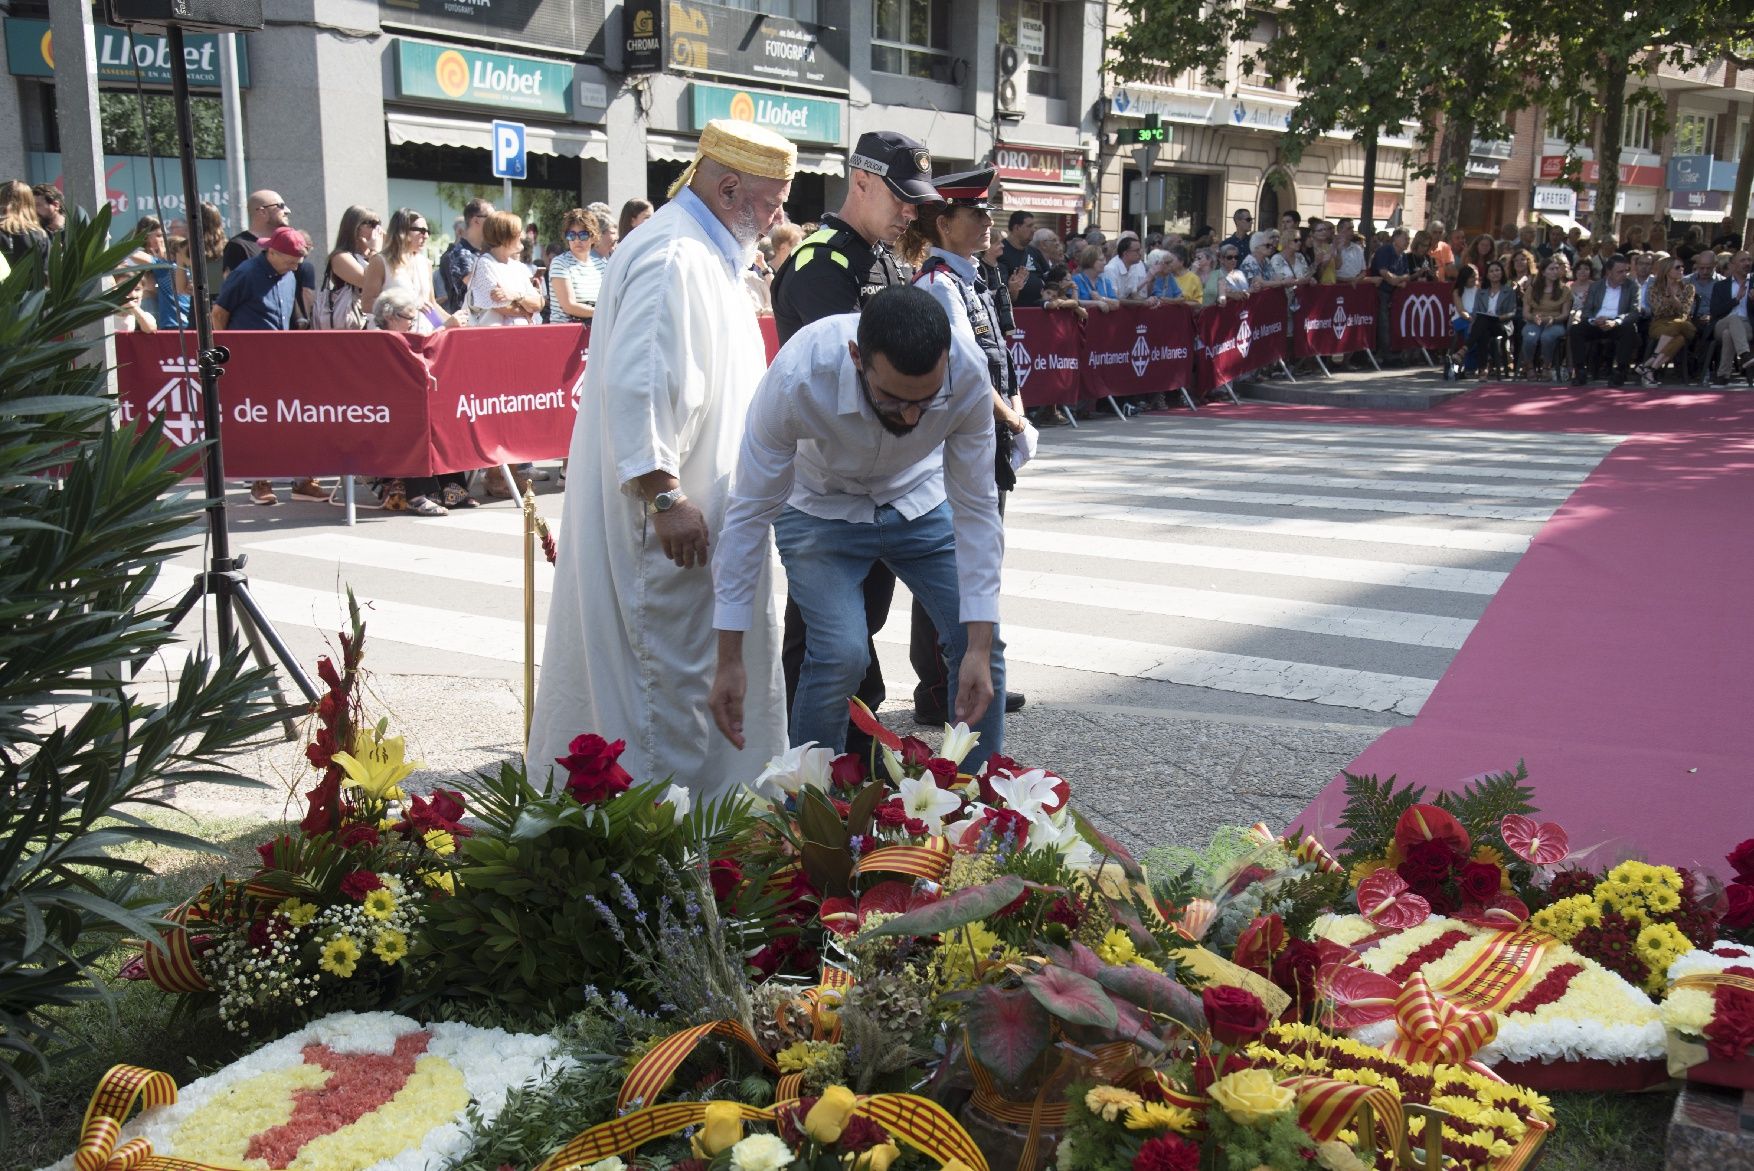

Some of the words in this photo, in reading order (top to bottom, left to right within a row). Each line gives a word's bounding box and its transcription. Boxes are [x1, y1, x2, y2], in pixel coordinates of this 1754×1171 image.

[101, 34, 215, 70] Llobet
[627, 38, 660, 52] CHROMA
[473, 60, 542, 95] Llobet
[756, 99, 808, 128] Llobet
[498, 127, 519, 171] P
[1034, 354, 1047, 370] de
[1088, 351, 1129, 369] Ajuntament
[1151, 348, 1160, 361] de
[234, 398, 268, 423] de
[277, 399, 390, 423] Manresa
[456, 388, 565, 422] Ajuntament
